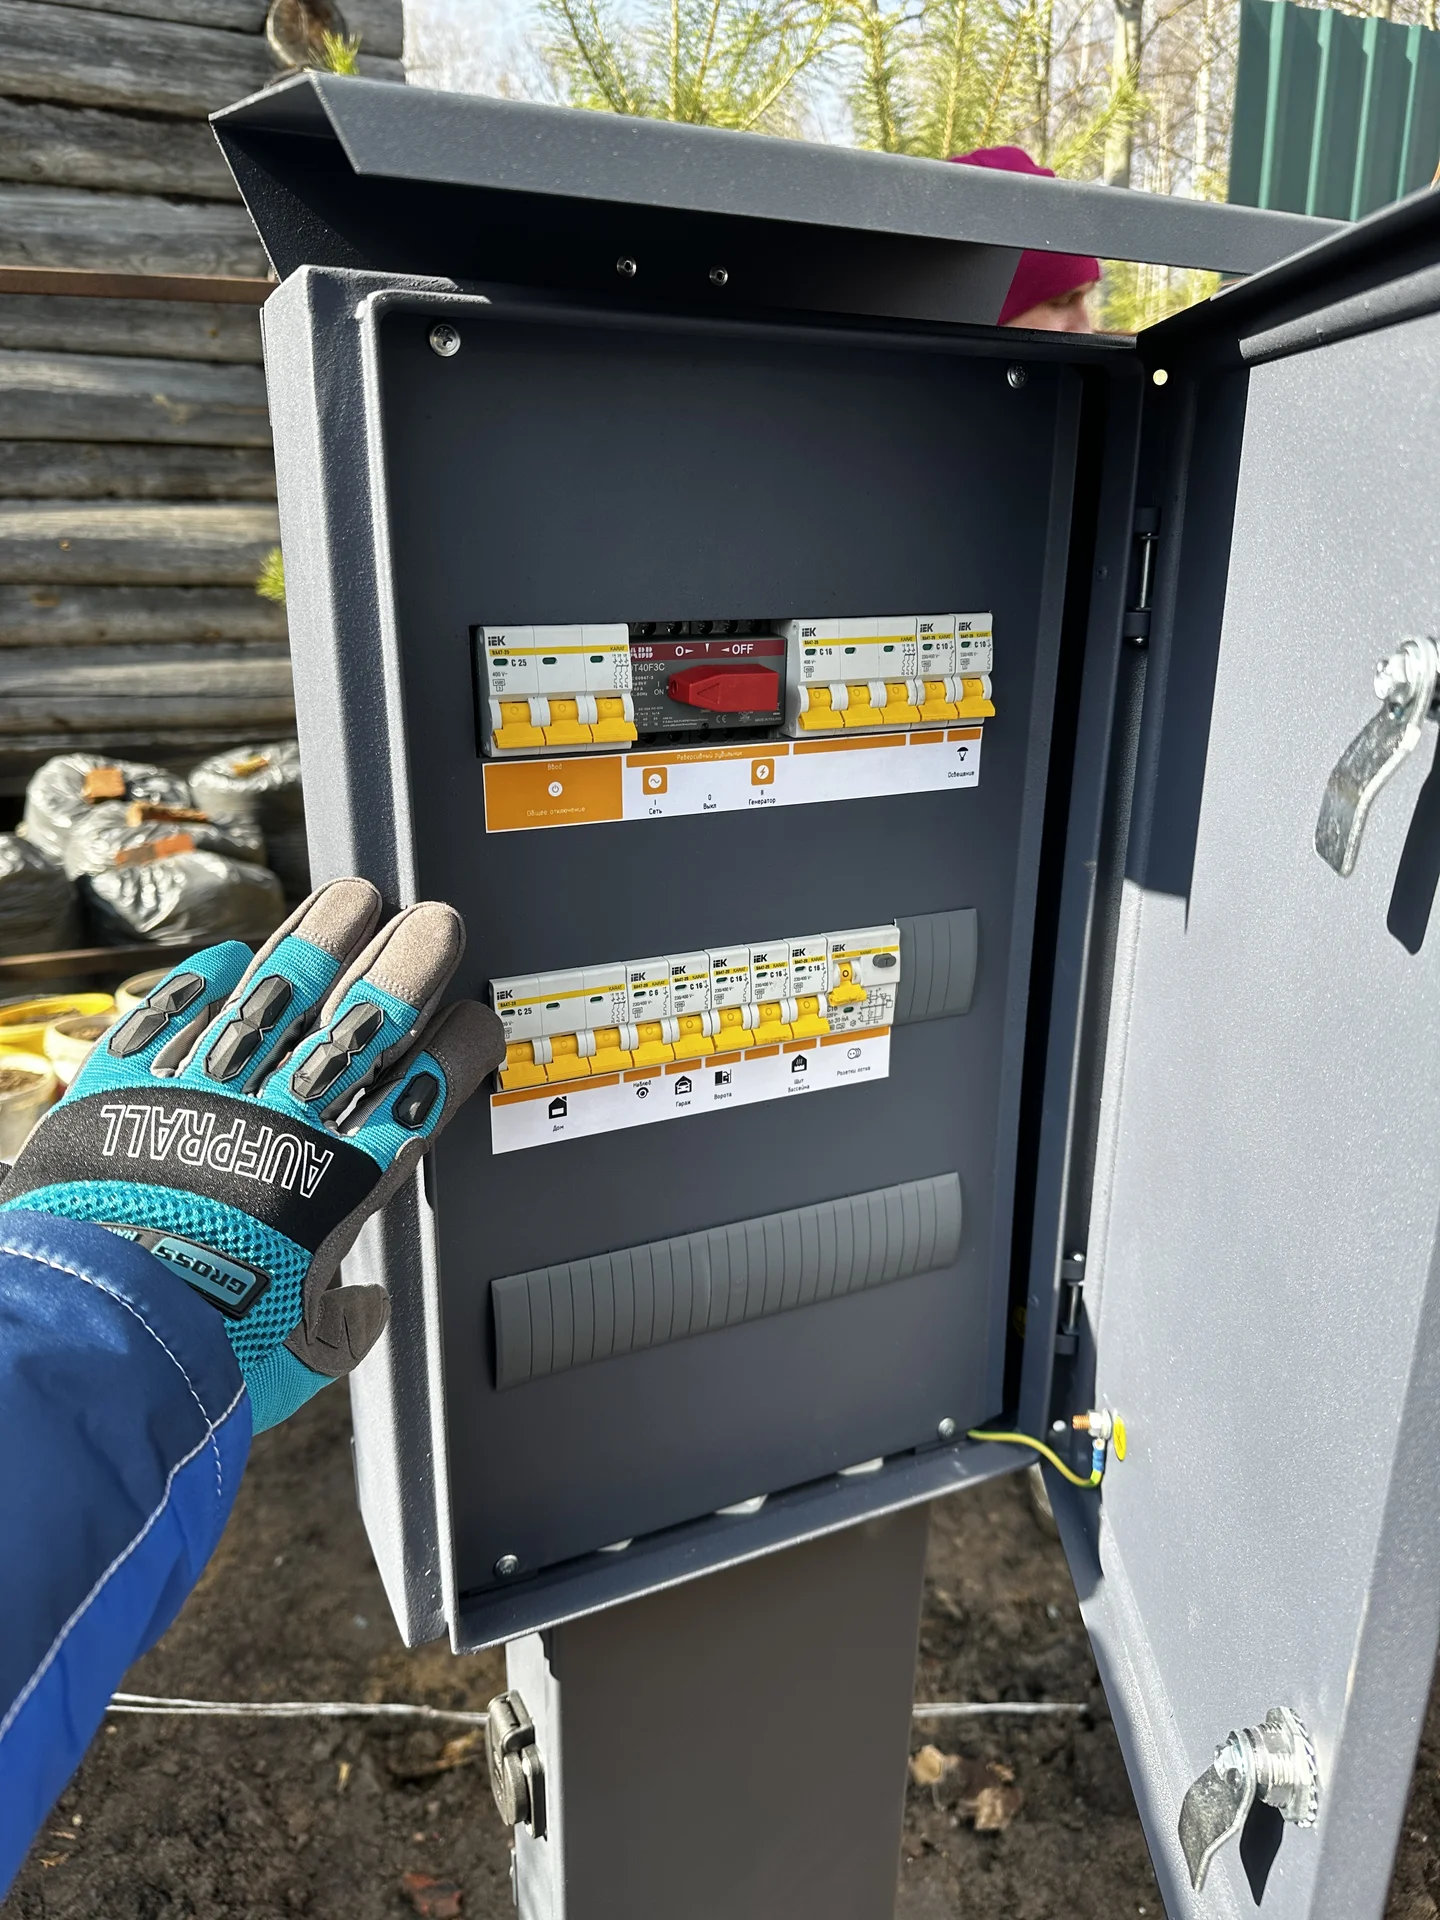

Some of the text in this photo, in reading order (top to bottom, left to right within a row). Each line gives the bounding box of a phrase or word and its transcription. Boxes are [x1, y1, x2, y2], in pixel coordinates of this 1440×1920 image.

[941, 642, 948, 650] 10
[979, 640, 986, 648] 10
[630, 646, 653, 659] ABB
[732, 643, 754, 655] OFF
[511, 658, 527, 667] C 25
[631, 662, 666, 672] T40F3C
[703, 802, 717, 810] Выкл
[748, 797, 776, 806] Генератор
[648, 807, 662, 815] Сеть
[517, 1007, 533, 1016] C 25
[713, 1092, 732, 1100] Ворота
[675, 1100, 691, 1108] Гараж
[552, 1124, 565, 1132] Дом
[100, 1104, 334, 1199] AUFPRALL
[154, 1245, 249, 1296] GROSS
